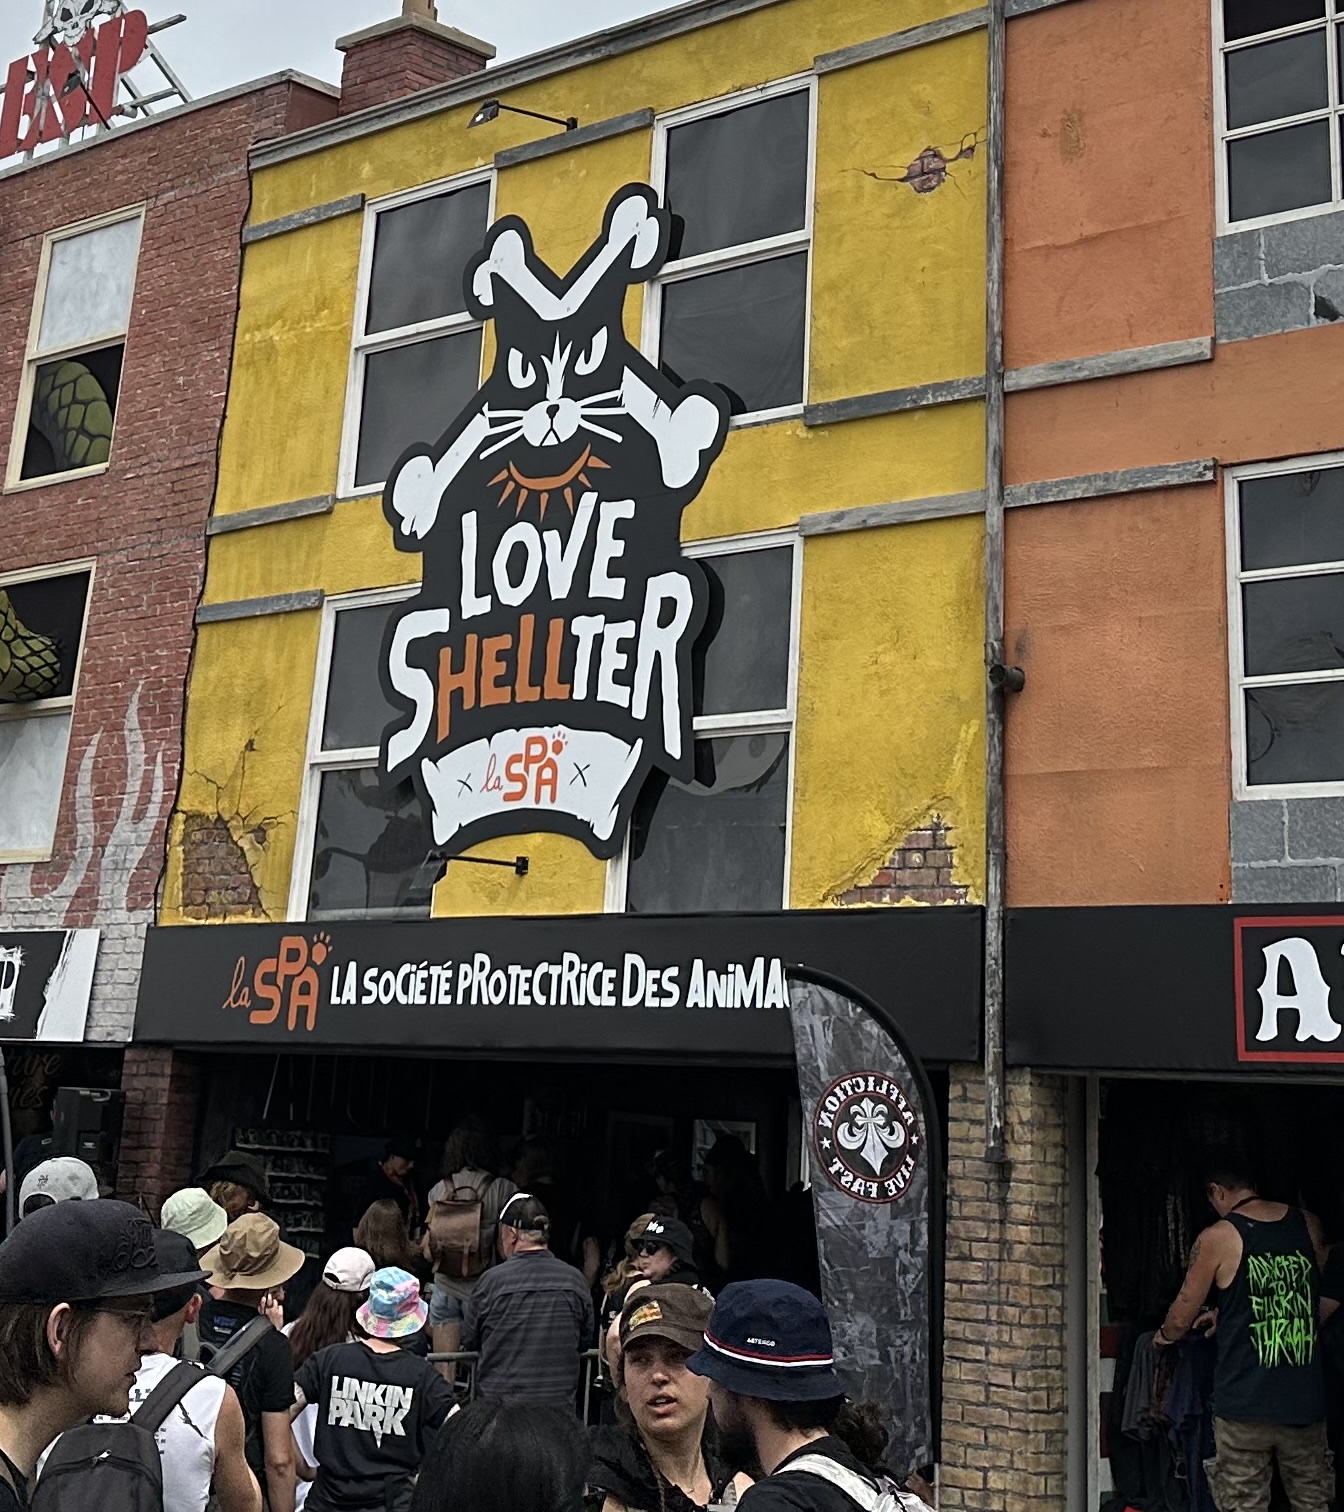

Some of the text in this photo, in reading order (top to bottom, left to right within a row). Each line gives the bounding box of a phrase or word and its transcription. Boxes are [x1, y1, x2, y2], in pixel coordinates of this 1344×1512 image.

[461, 491, 636, 619] LOVE
[387, 572, 693, 773] SHELLTER
[502, 735, 558, 804] SPA
[249, 935, 320, 1032] SPA
[330, 960, 358, 1005] LA
[622, 954, 680, 1008] DES
[686, 956, 791, 1008] ANiMA
[1247, 1250, 1312, 1295] ADDICTED
[1269, 1280, 1287, 1296] TO
[1248, 1317, 1316, 1368] THRASH
[330, 1375, 414, 1410] LINKIN
[327, 1397, 411, 1449] PARK
